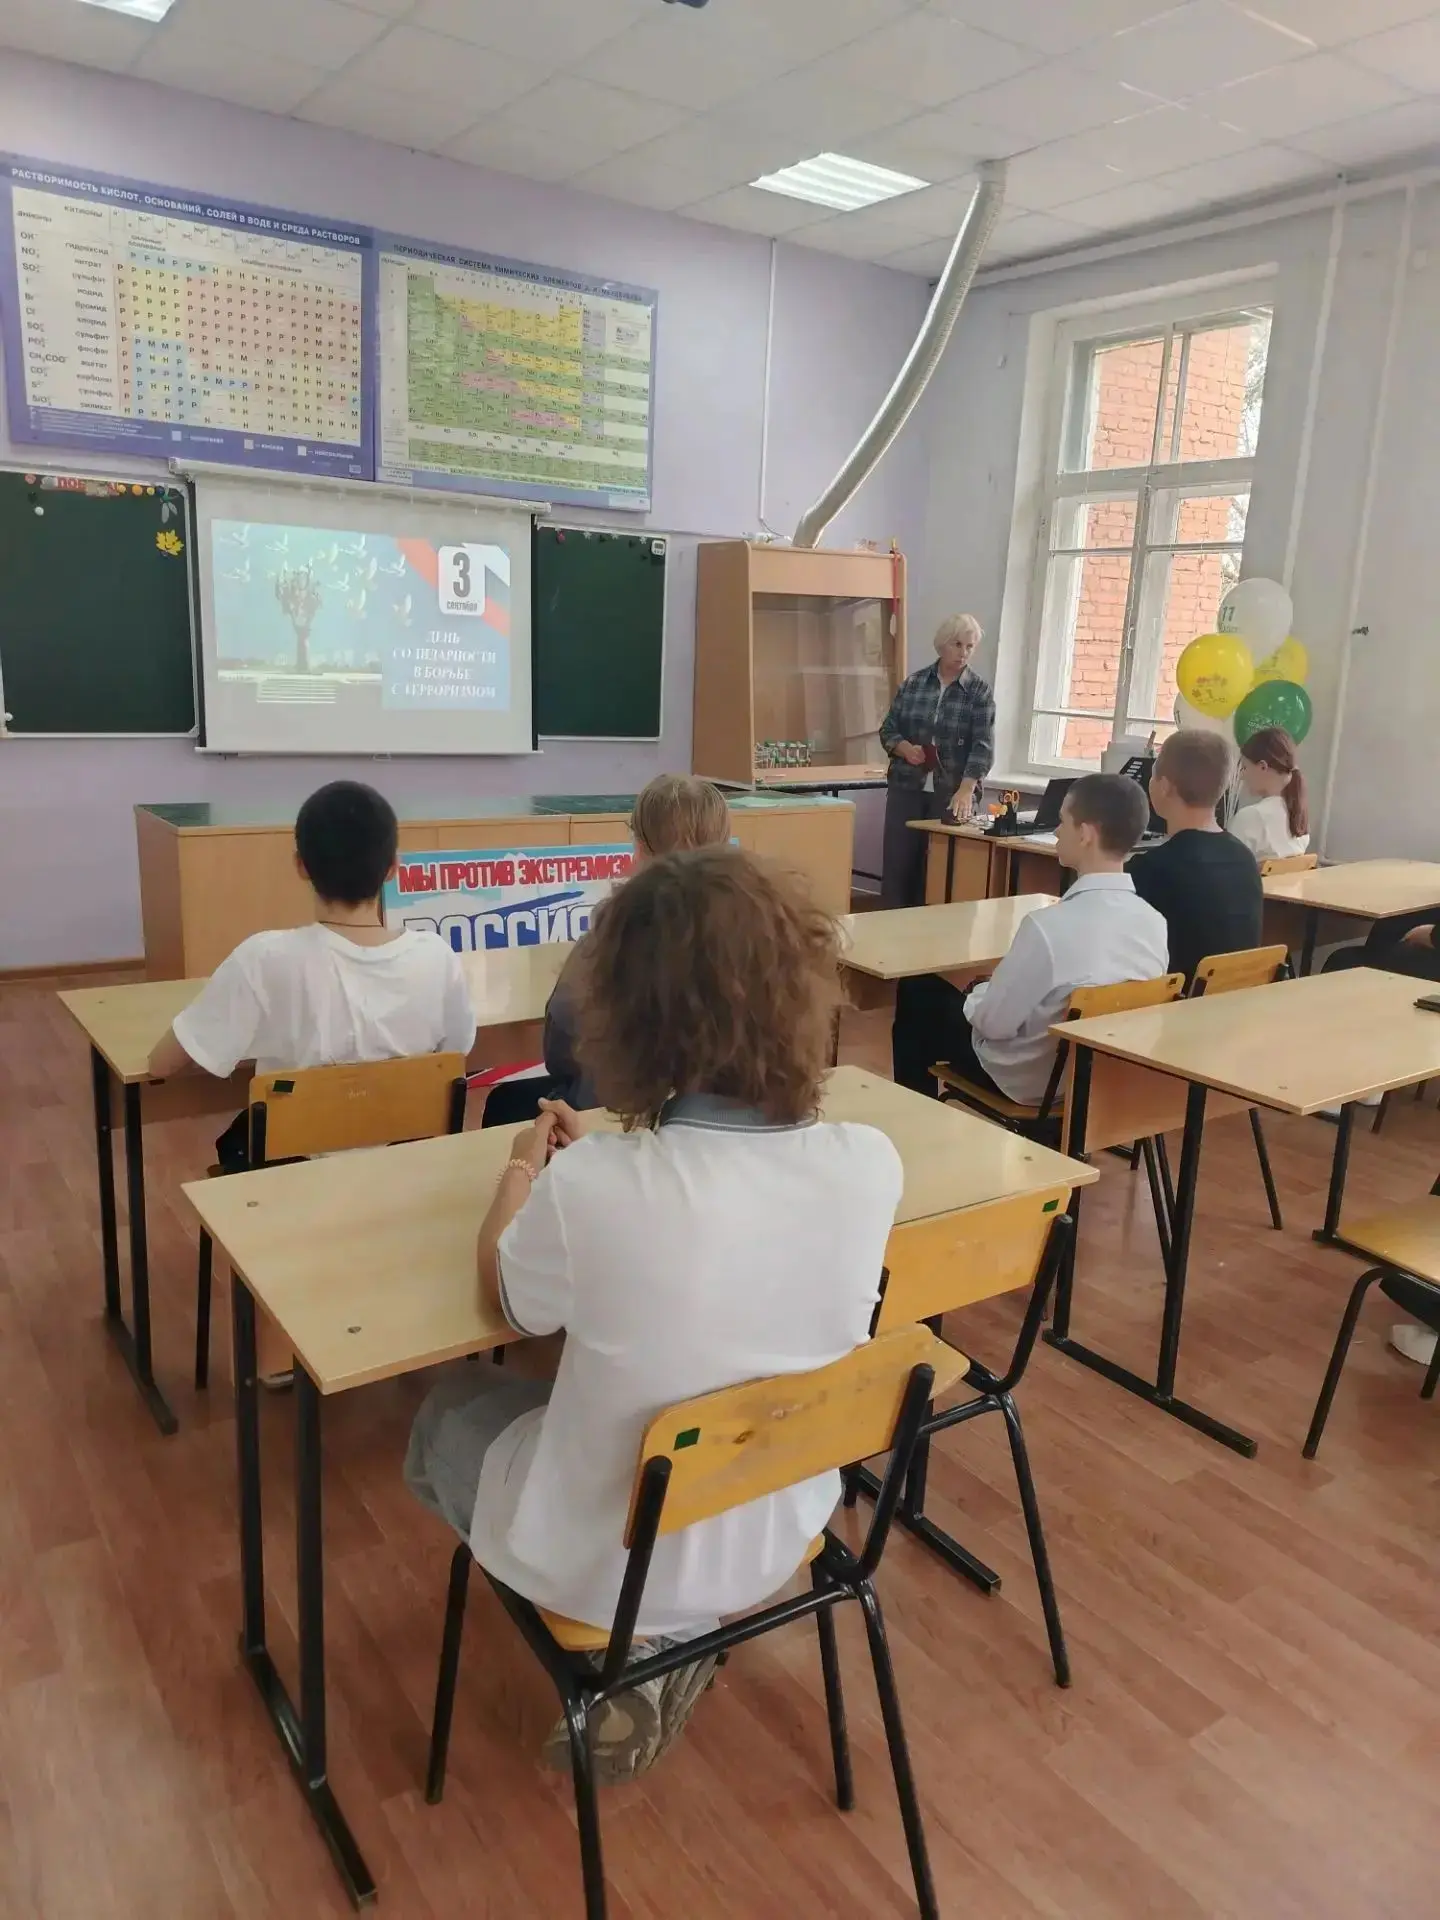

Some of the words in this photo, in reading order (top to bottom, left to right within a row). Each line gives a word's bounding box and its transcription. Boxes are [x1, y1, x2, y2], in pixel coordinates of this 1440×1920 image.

[12, 168, 98, 193] РАСТВОРИМОСТЬ
[101, 186, 142, 203] КИСЛОТ,
[144, 195, 205, 216] ОСНОВАНИЙ,
[206, 208, 237, 221] СОЛЕЙ
[239, 215, 246, 223] В
[247, 216, 272, 229] ВОДЕ
[281, 223, 310, 236] СРЕДА
[311, 228, 361, 245] РАСТВОРОВ
[394, 244, 456, 264] ПЕРИОДИЧЕСКАЯ
[458, 258, 492, 270] СИСТЕМА
[494, 264, 540, 280] ХИМИЧЕСКИХ
[452, 552, 471, 598] 3
[1223, 606, 1236, 622] 11
[426, 630, 461, 645] ДЕНЬ
[414, 666, 422, 678] В
[424, 666, 474, 680] БОРЬБЕ
[391, 683, 401, 695] С
[399, 863, 437, 893] МЫ
[439, 859, 515, 890] ПРОТИВ
